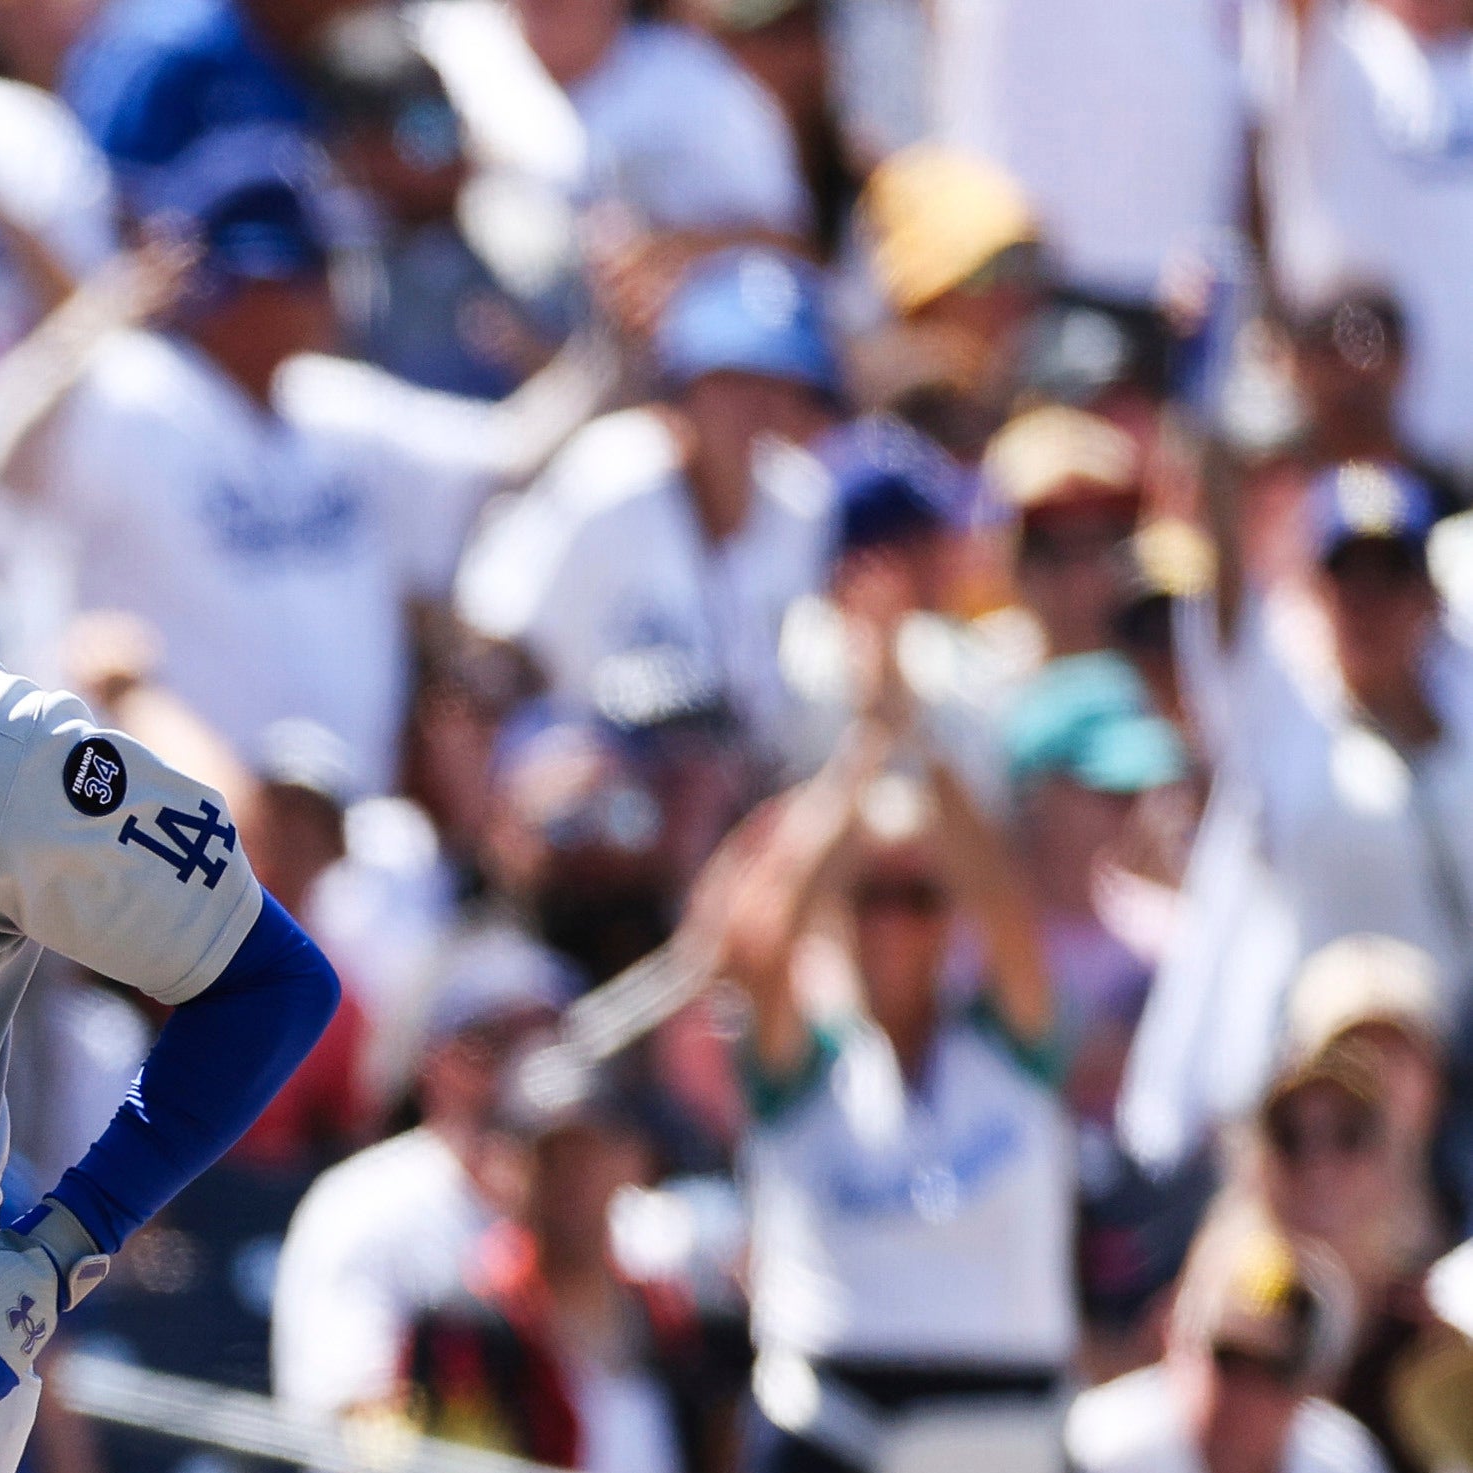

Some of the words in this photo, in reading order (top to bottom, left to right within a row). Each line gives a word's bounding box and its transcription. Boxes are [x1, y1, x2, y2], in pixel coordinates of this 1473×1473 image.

[72, 747, 94, 794] FERNANDO
[85, 755, 119, 804] 34
[118, 798, 236, 890] LA
